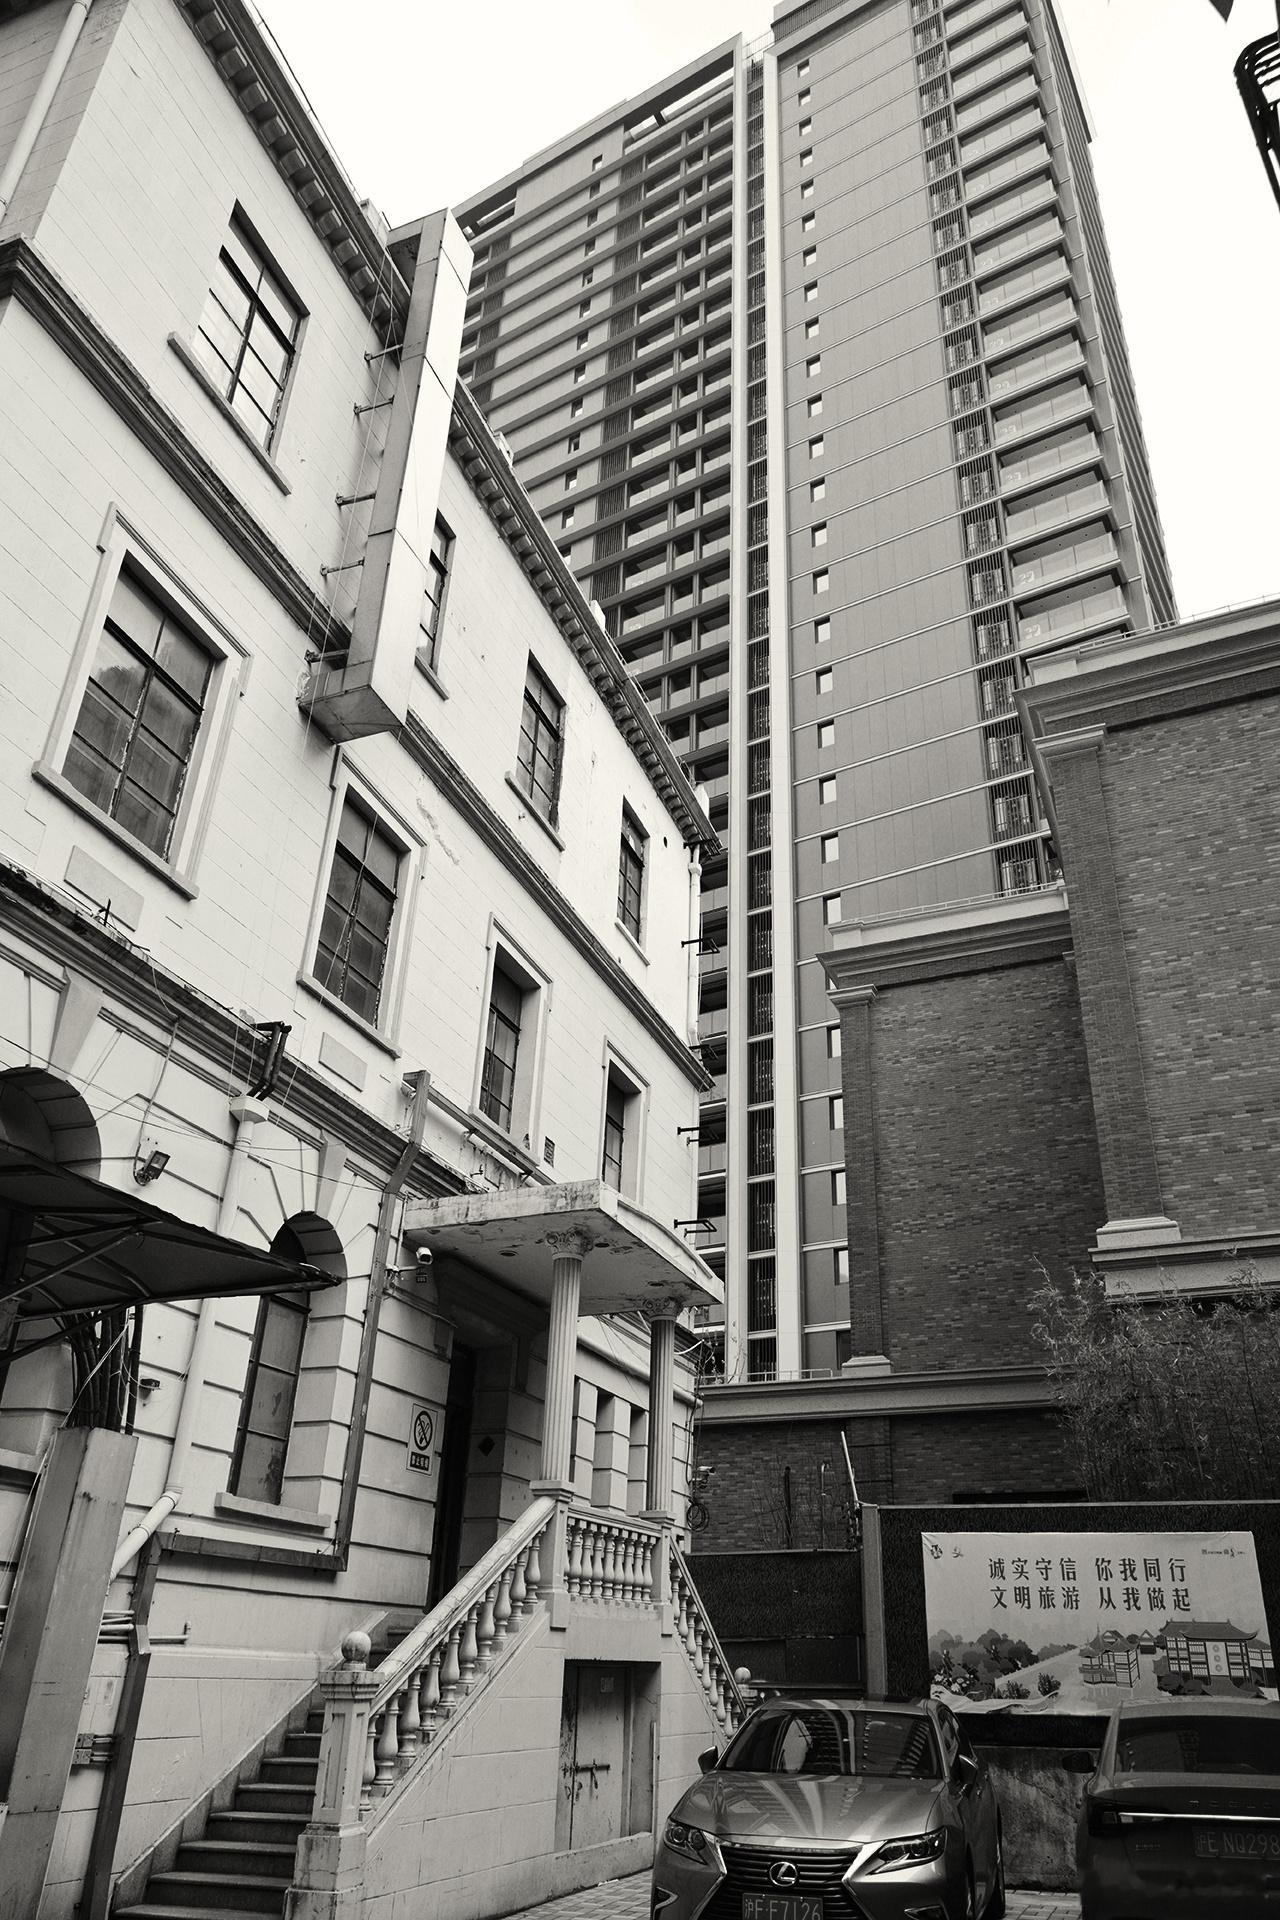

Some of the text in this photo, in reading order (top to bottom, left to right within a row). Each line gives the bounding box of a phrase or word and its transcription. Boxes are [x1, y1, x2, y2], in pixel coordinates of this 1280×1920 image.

[988, 1557, 1186, 1582] 诚实守信 你我同行
[990, 1586, 1191, 1612] 文明旅游 从我做起
